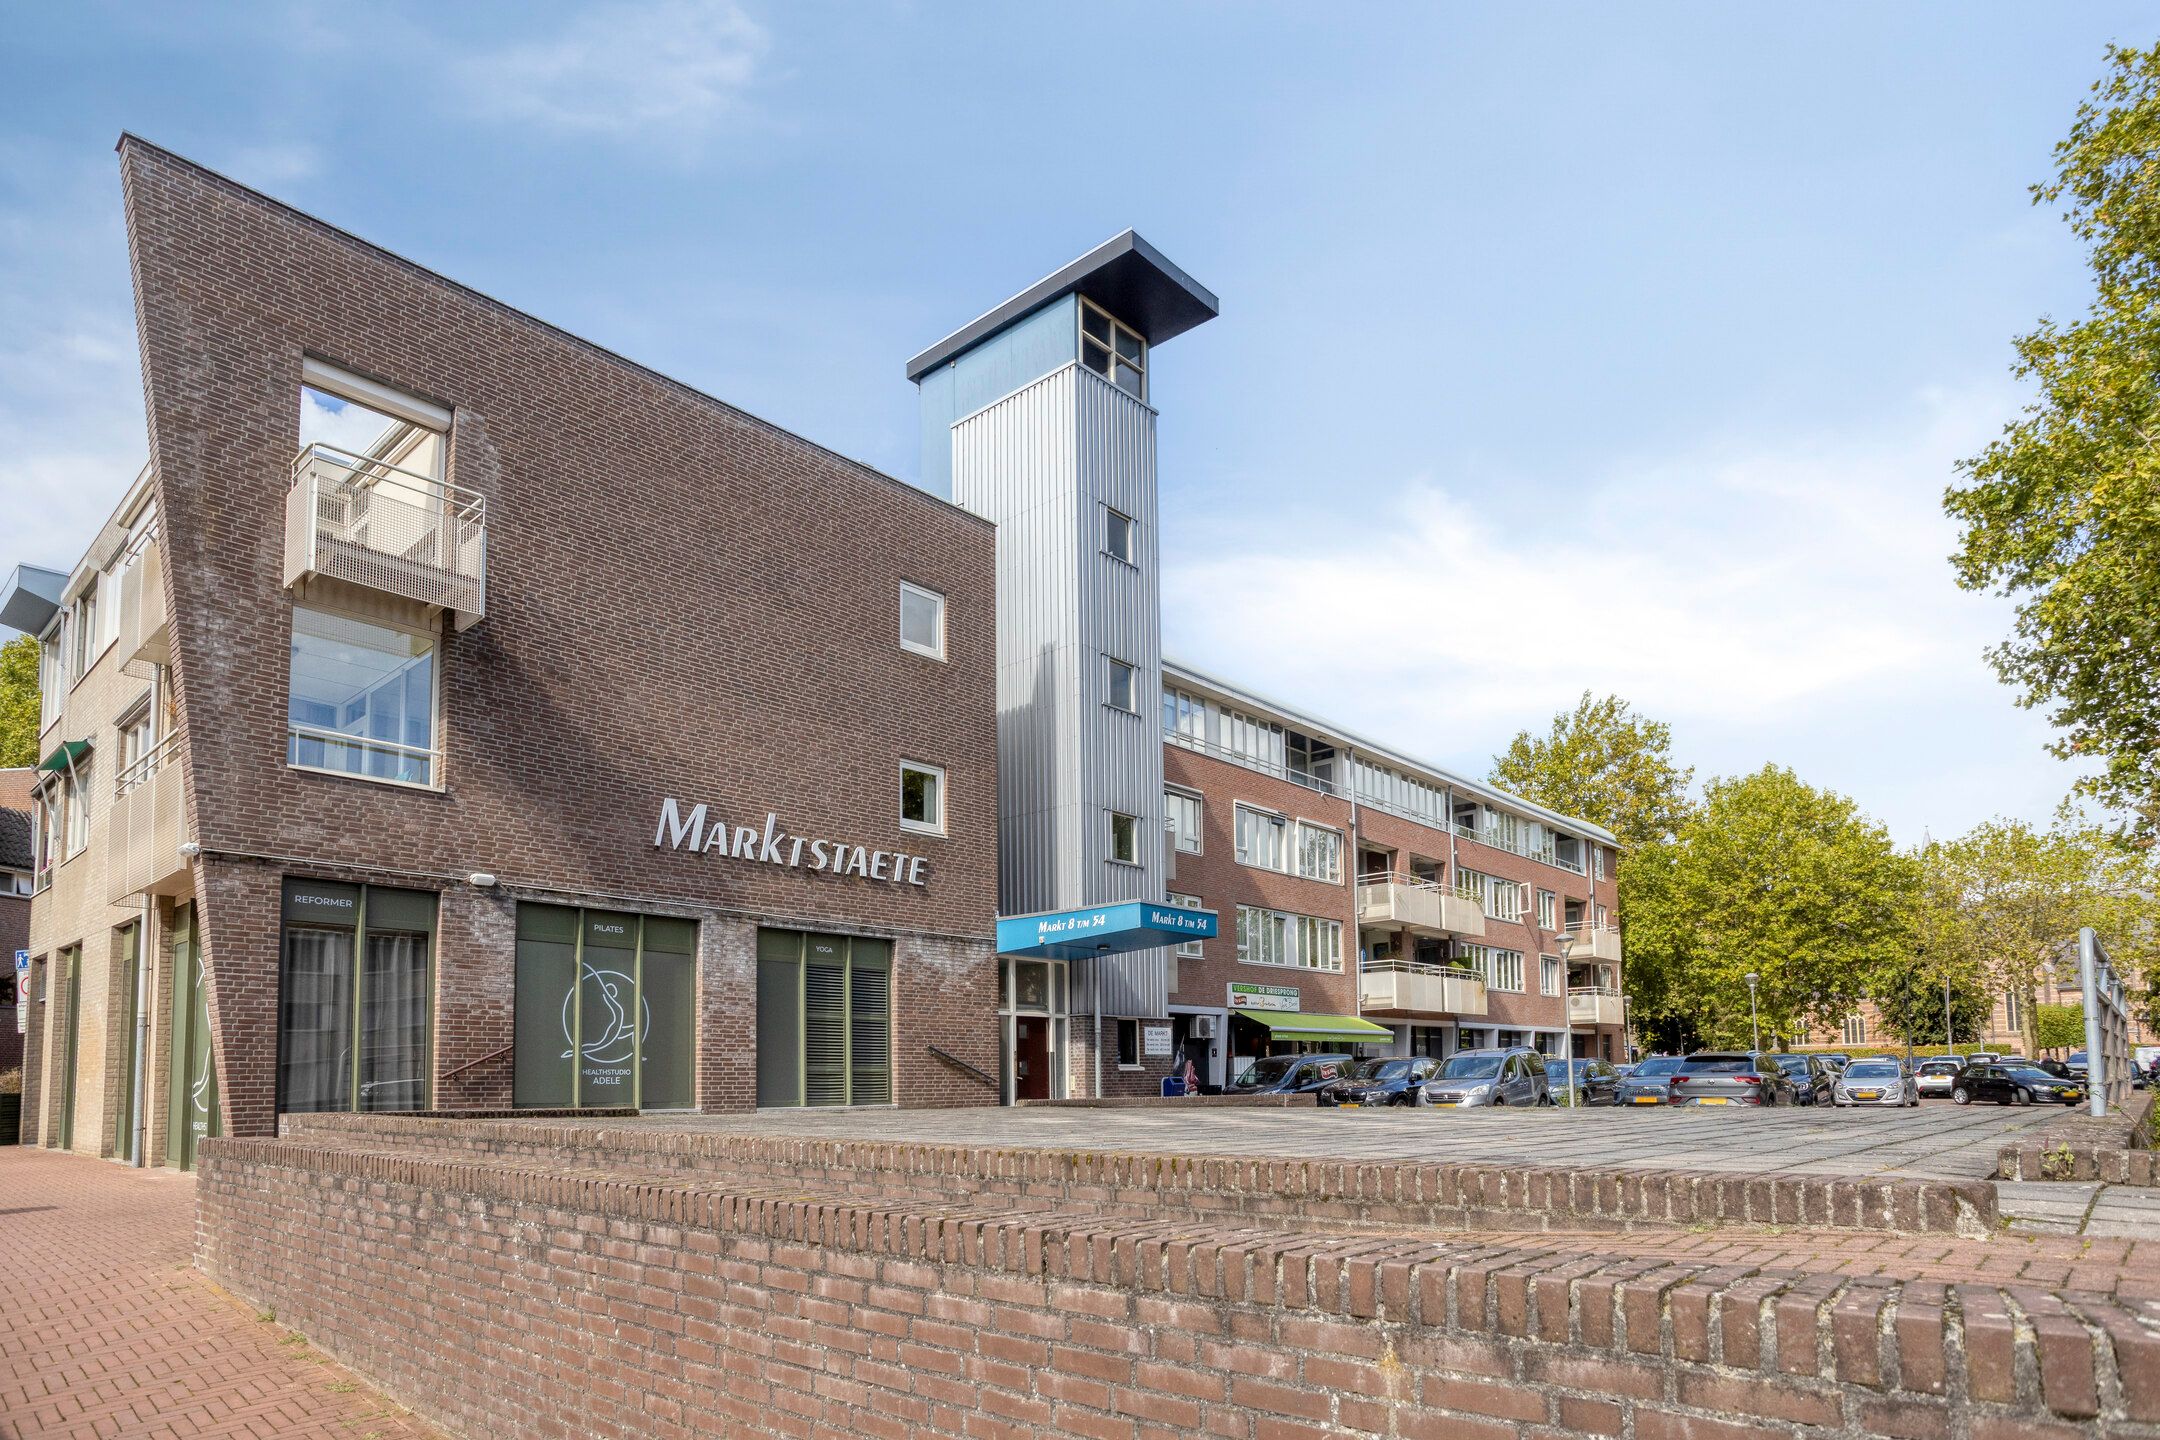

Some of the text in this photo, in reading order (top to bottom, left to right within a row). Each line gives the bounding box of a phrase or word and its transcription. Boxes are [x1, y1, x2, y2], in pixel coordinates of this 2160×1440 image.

[294, 894, 353, 908] REFORMER
[594, 924, 624, 933] PILATES
[1067, 917, 1075, 930] 8
[1092, 914, 1106, 927] 54
[1178, 916, 1184, 927] 8
[1196, 918, 1207, 930] 54
[815, 945, 833, 953] YOGA
[1233, 984, 1298, 997] VERSHOF DE DRIESPRONG
[592, 1076, 621, 1085] ADELE
